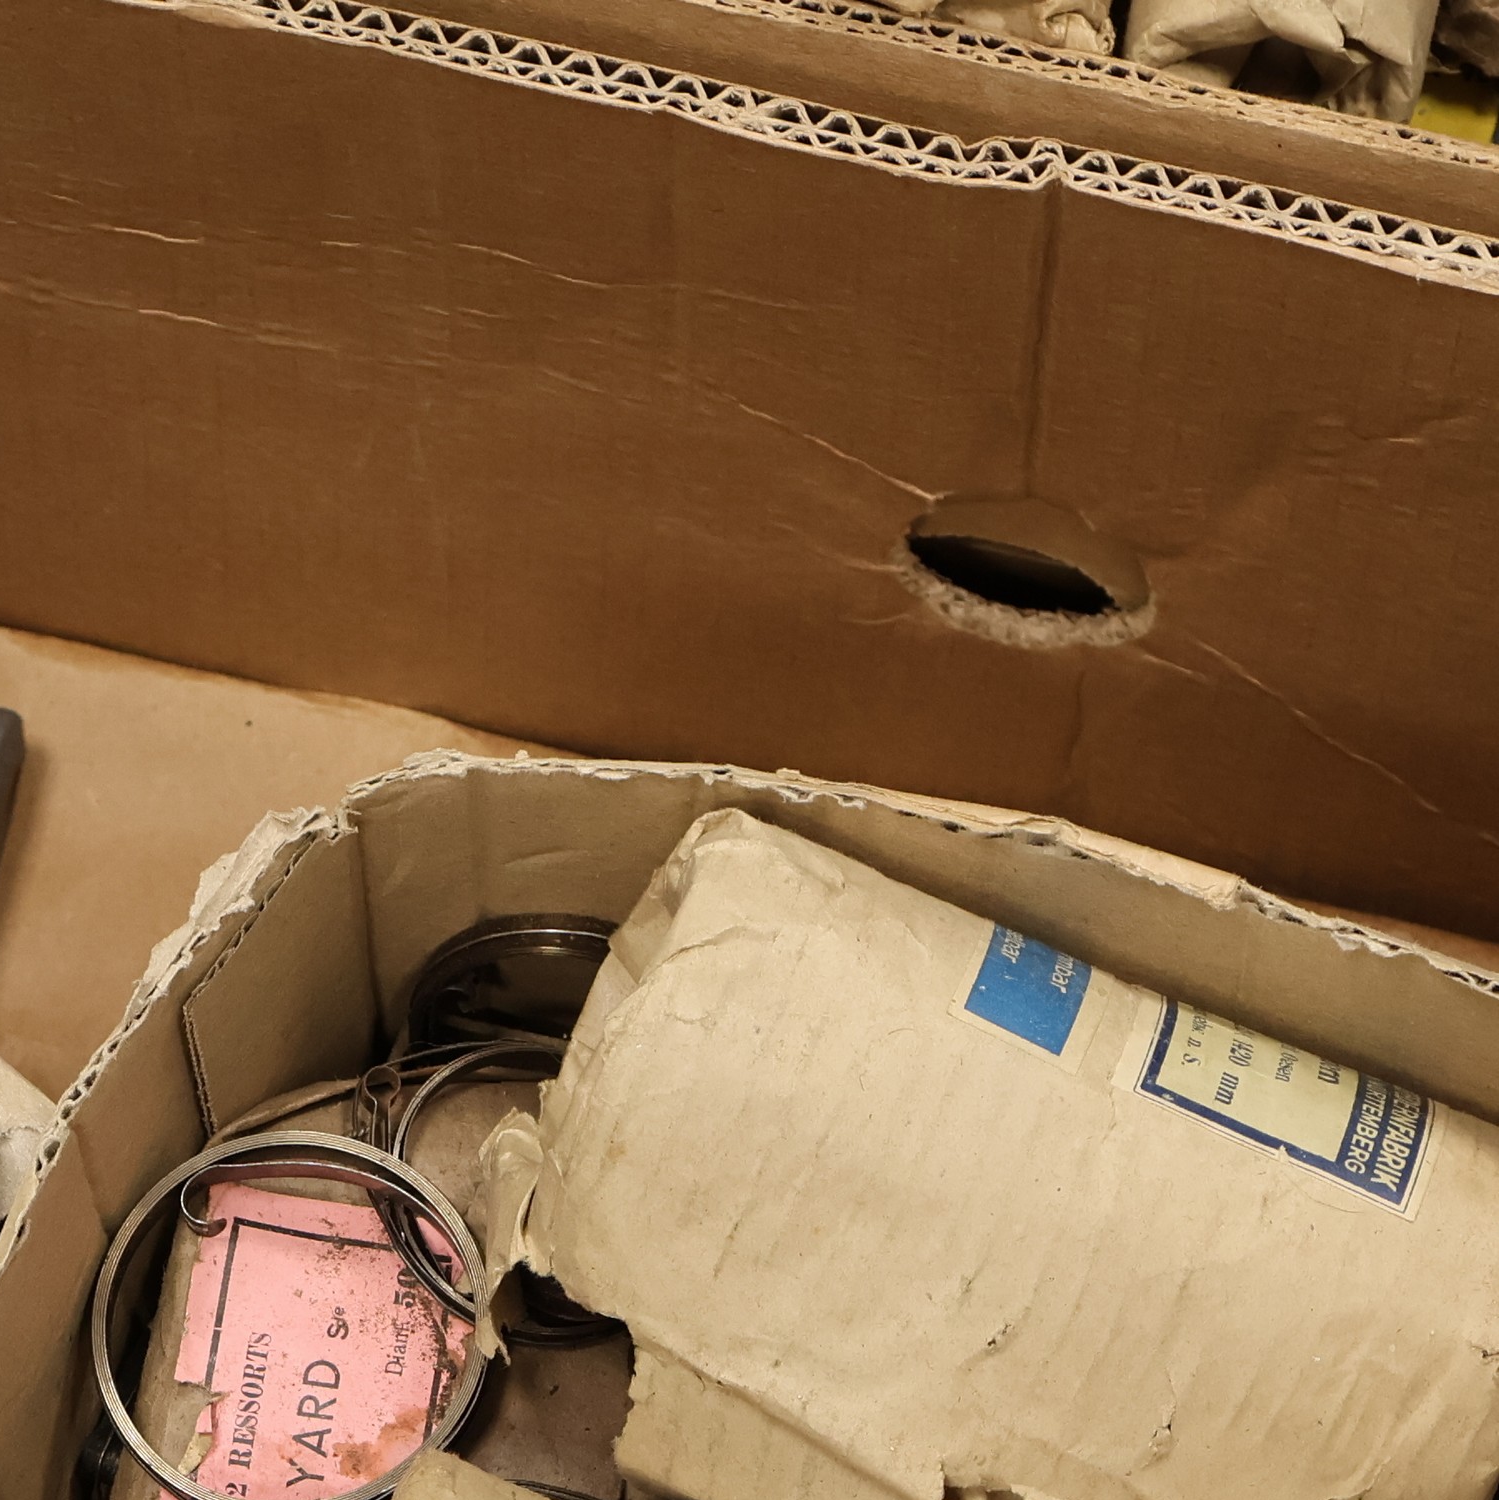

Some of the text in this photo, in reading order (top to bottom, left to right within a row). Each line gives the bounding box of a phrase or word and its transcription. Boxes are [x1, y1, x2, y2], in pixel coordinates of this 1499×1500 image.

[1214, 1071, 1239, 1105] mm
[228, 1332, 272, 1469] RESSORTS
[286, 1359, 341, 1488] YARD
